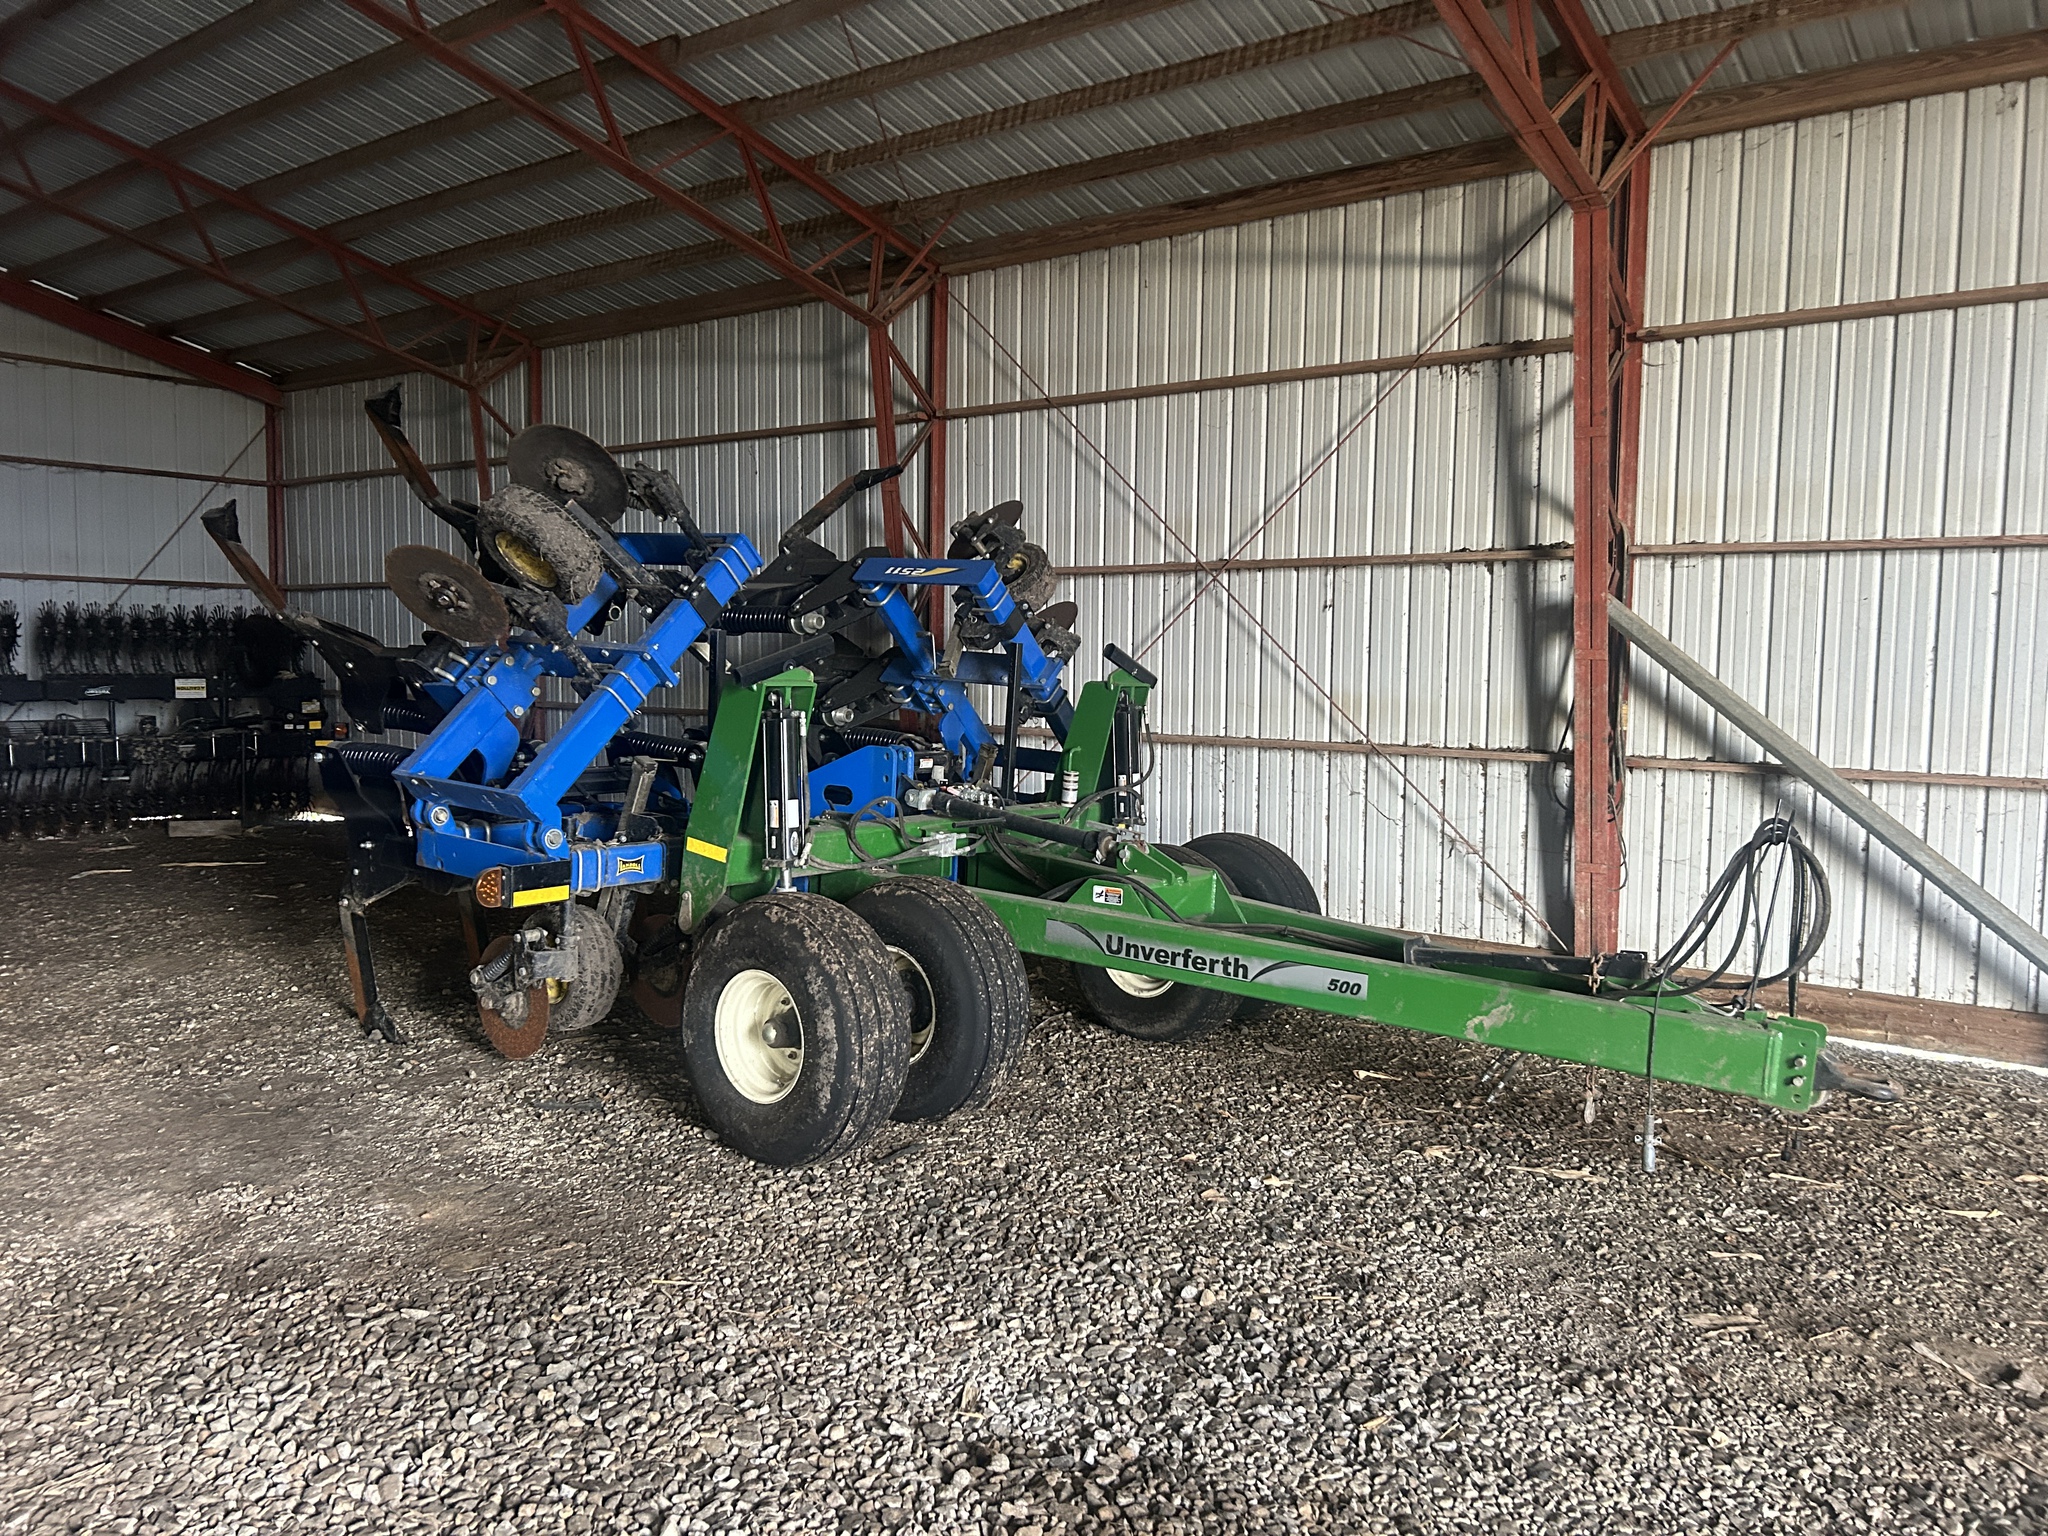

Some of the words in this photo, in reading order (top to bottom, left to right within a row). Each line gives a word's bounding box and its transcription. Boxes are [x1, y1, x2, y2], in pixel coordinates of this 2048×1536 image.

[885, 566, 927, 576] 2511
[1105, 934, 1249, 979] Unverferth
[1327, 978, 1362, 996] 500
